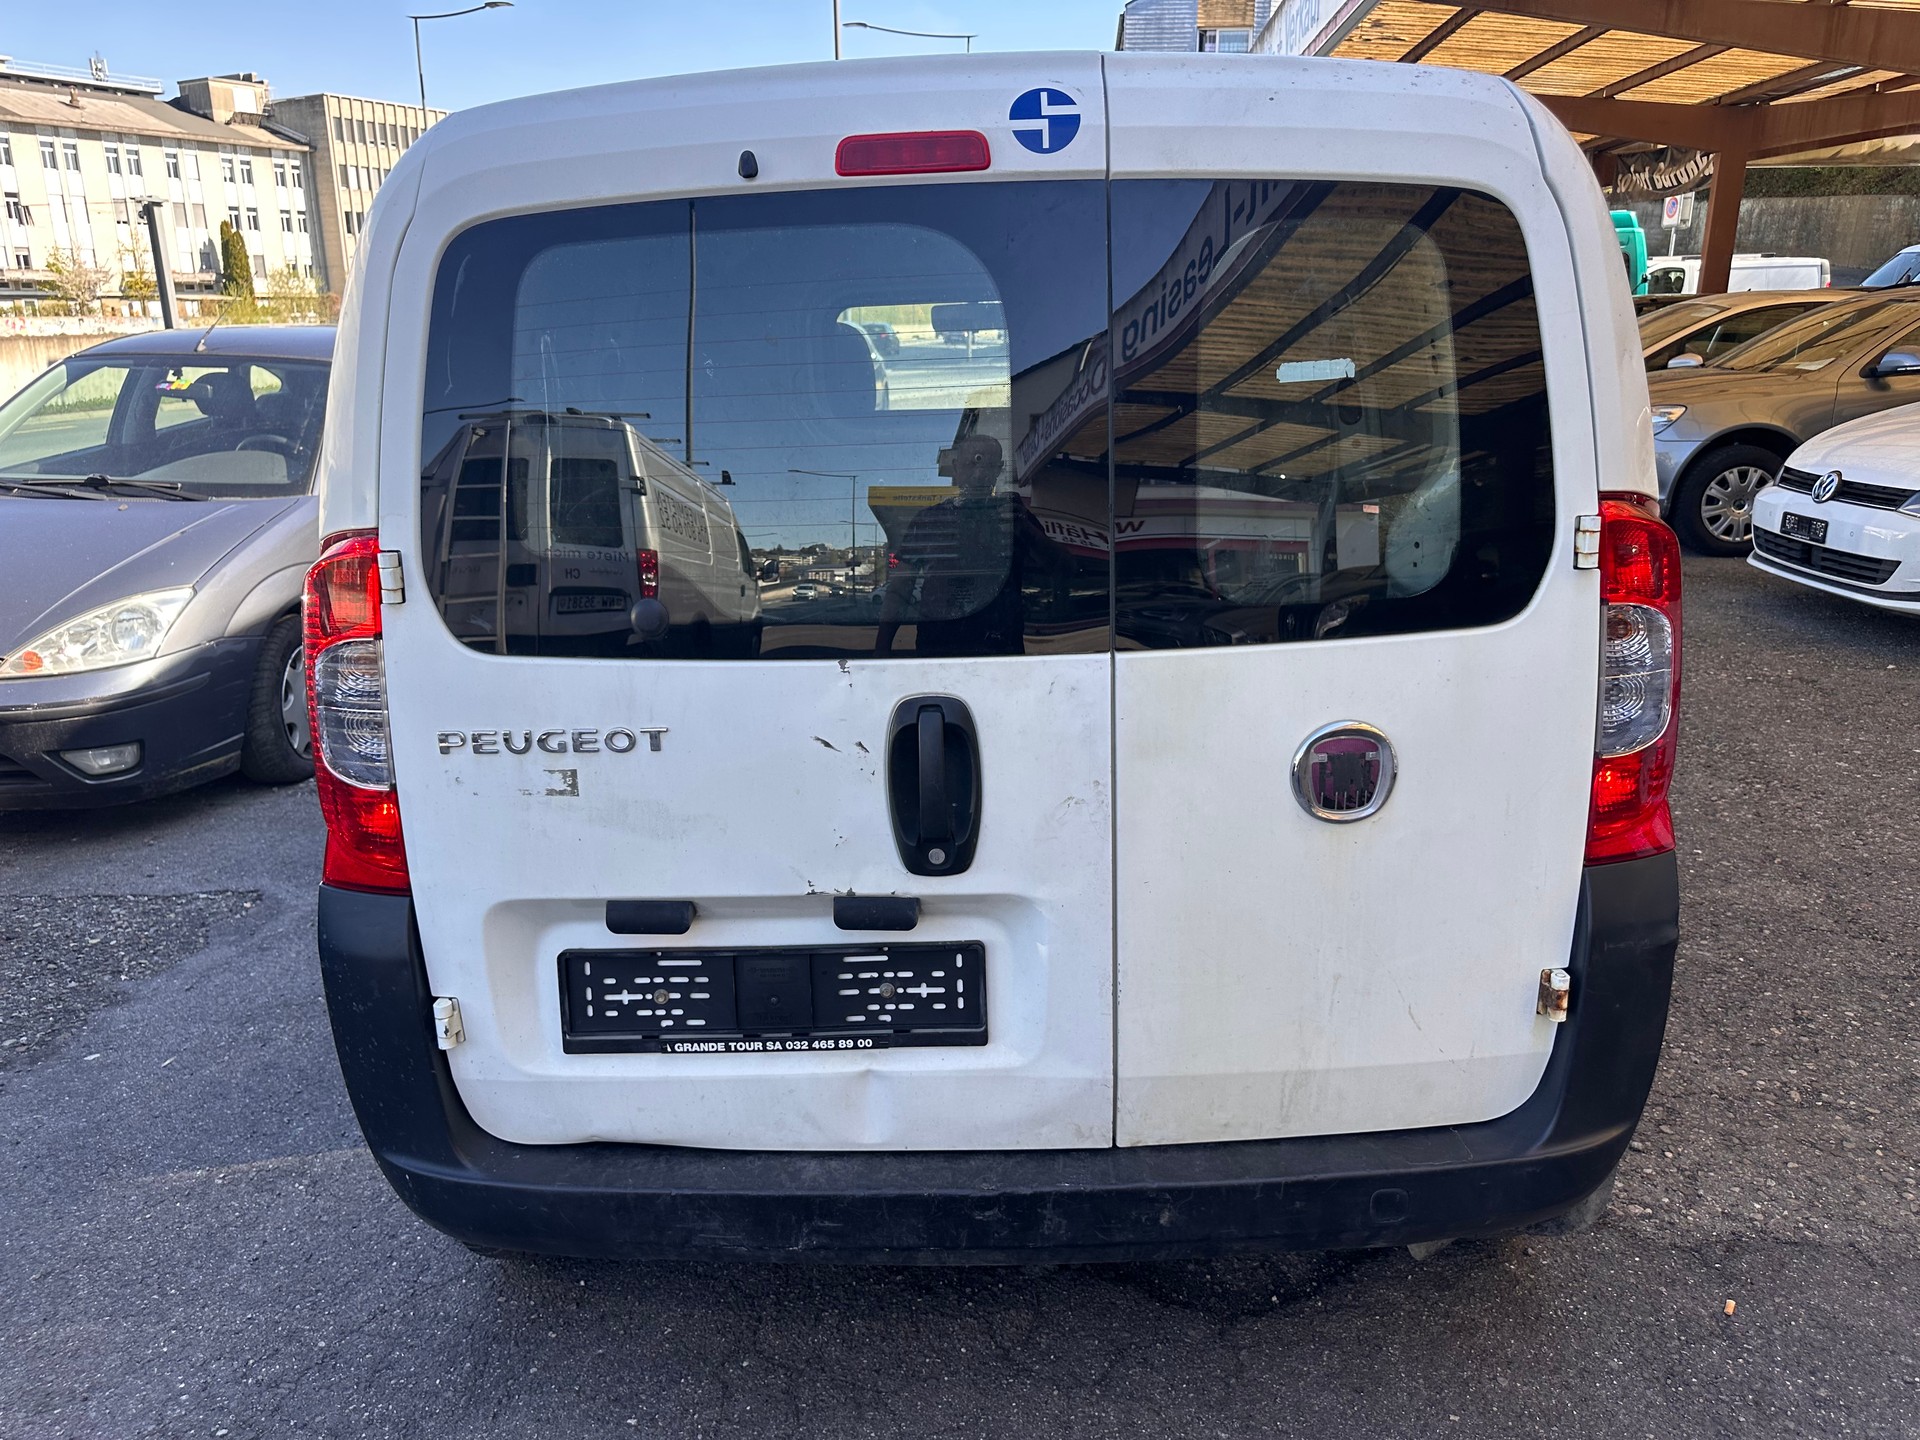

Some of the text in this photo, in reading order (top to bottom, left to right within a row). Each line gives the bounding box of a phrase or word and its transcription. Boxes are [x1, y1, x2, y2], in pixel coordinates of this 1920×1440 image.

[437, 727, 669, 755] PEUGEOT
[674, 1042, 726, 1052] GRANDE
[728, 1041, 763, 1051] TOUR
[766, 1041, 782, 1050] SA
[785, 1040, 809, 1050] 032
[812, 1039, 835, 1049] 465
[838, 1039, 854, 1048] 89
[857, 1038, 873, 1048] 00
